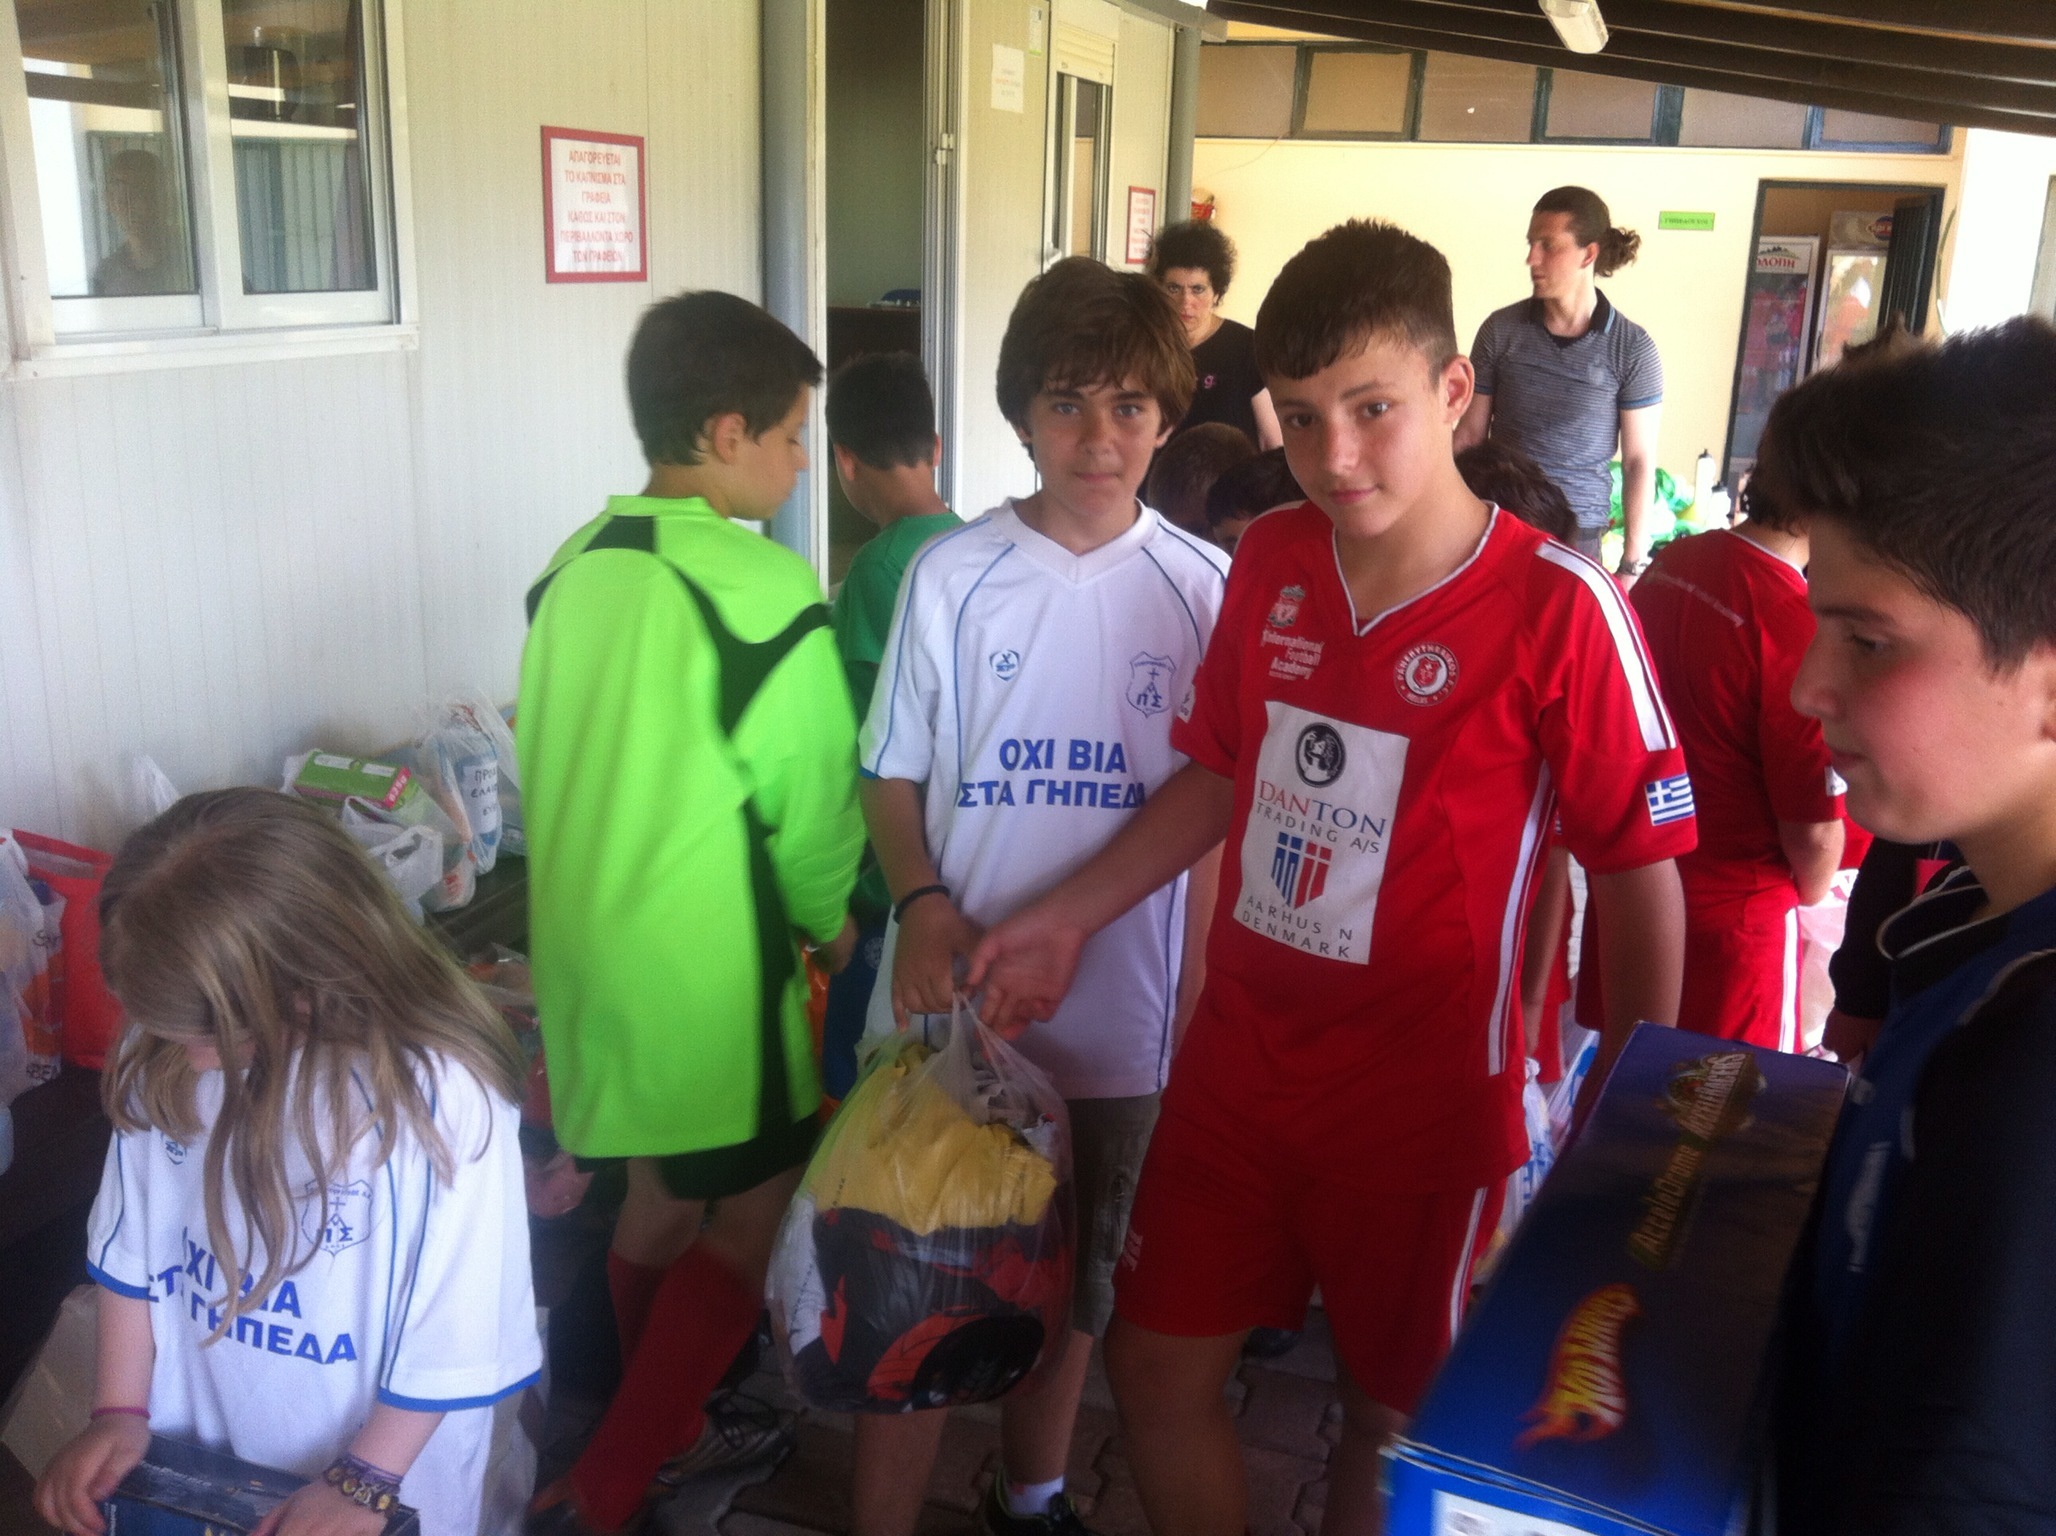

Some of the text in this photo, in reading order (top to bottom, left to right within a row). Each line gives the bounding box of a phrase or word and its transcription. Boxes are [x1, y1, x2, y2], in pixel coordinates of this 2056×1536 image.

[999, 738, 1127, 773] ΟΧΙ ΒΙΑ
[958, 780, 1016, 808] ΣΤΑ
[1260, 780, 1386, 838] DANTON
[1256, 802, 1380, 854] TRADING A/S
[1242, 910, 1349, 958] DENMARK
[1247, 896, 1353, 941] AARHUS N
